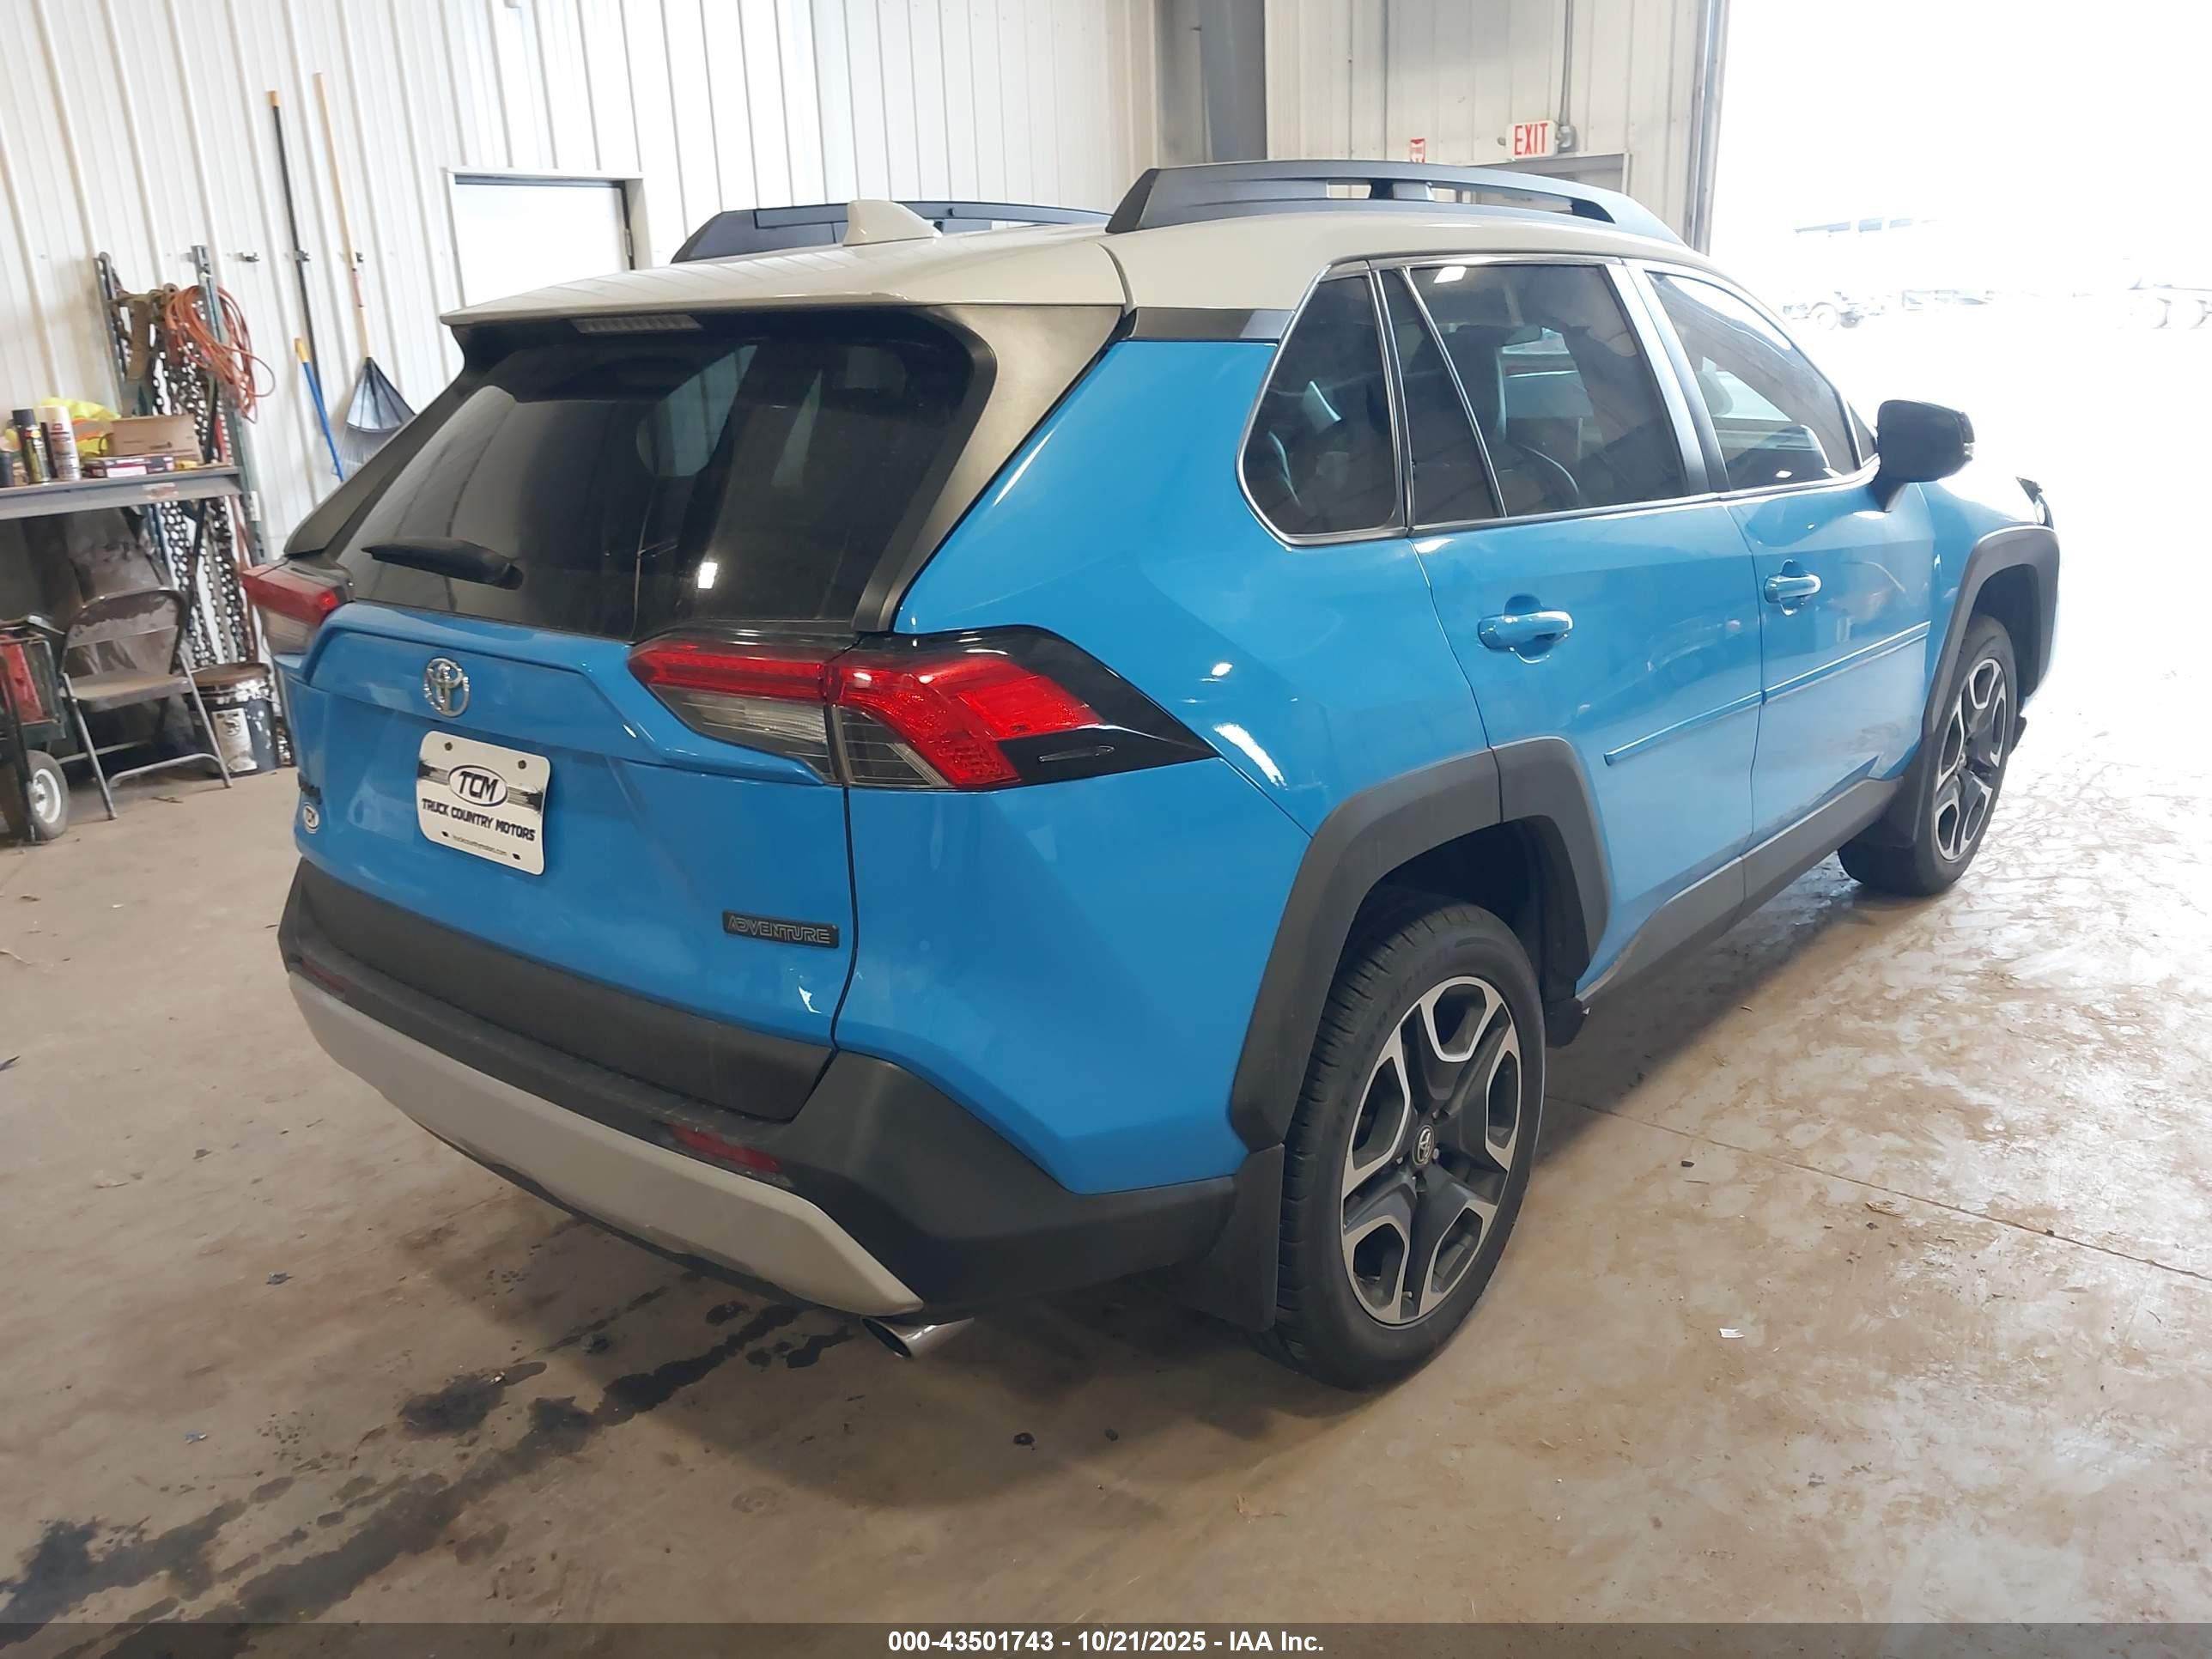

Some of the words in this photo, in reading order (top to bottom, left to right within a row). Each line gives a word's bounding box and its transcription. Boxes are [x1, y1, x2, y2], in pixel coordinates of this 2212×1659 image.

[1514, 122, 1548, 155] EXIT
[459, 770, 500, 802] TCM
[422, 798, 450, 817] TRUCK
[451, 806, 494, 829] COUNTRY
[495, 818, 537, 842] MOTORS
[727, 915, 831, 945] ADVENTURE
